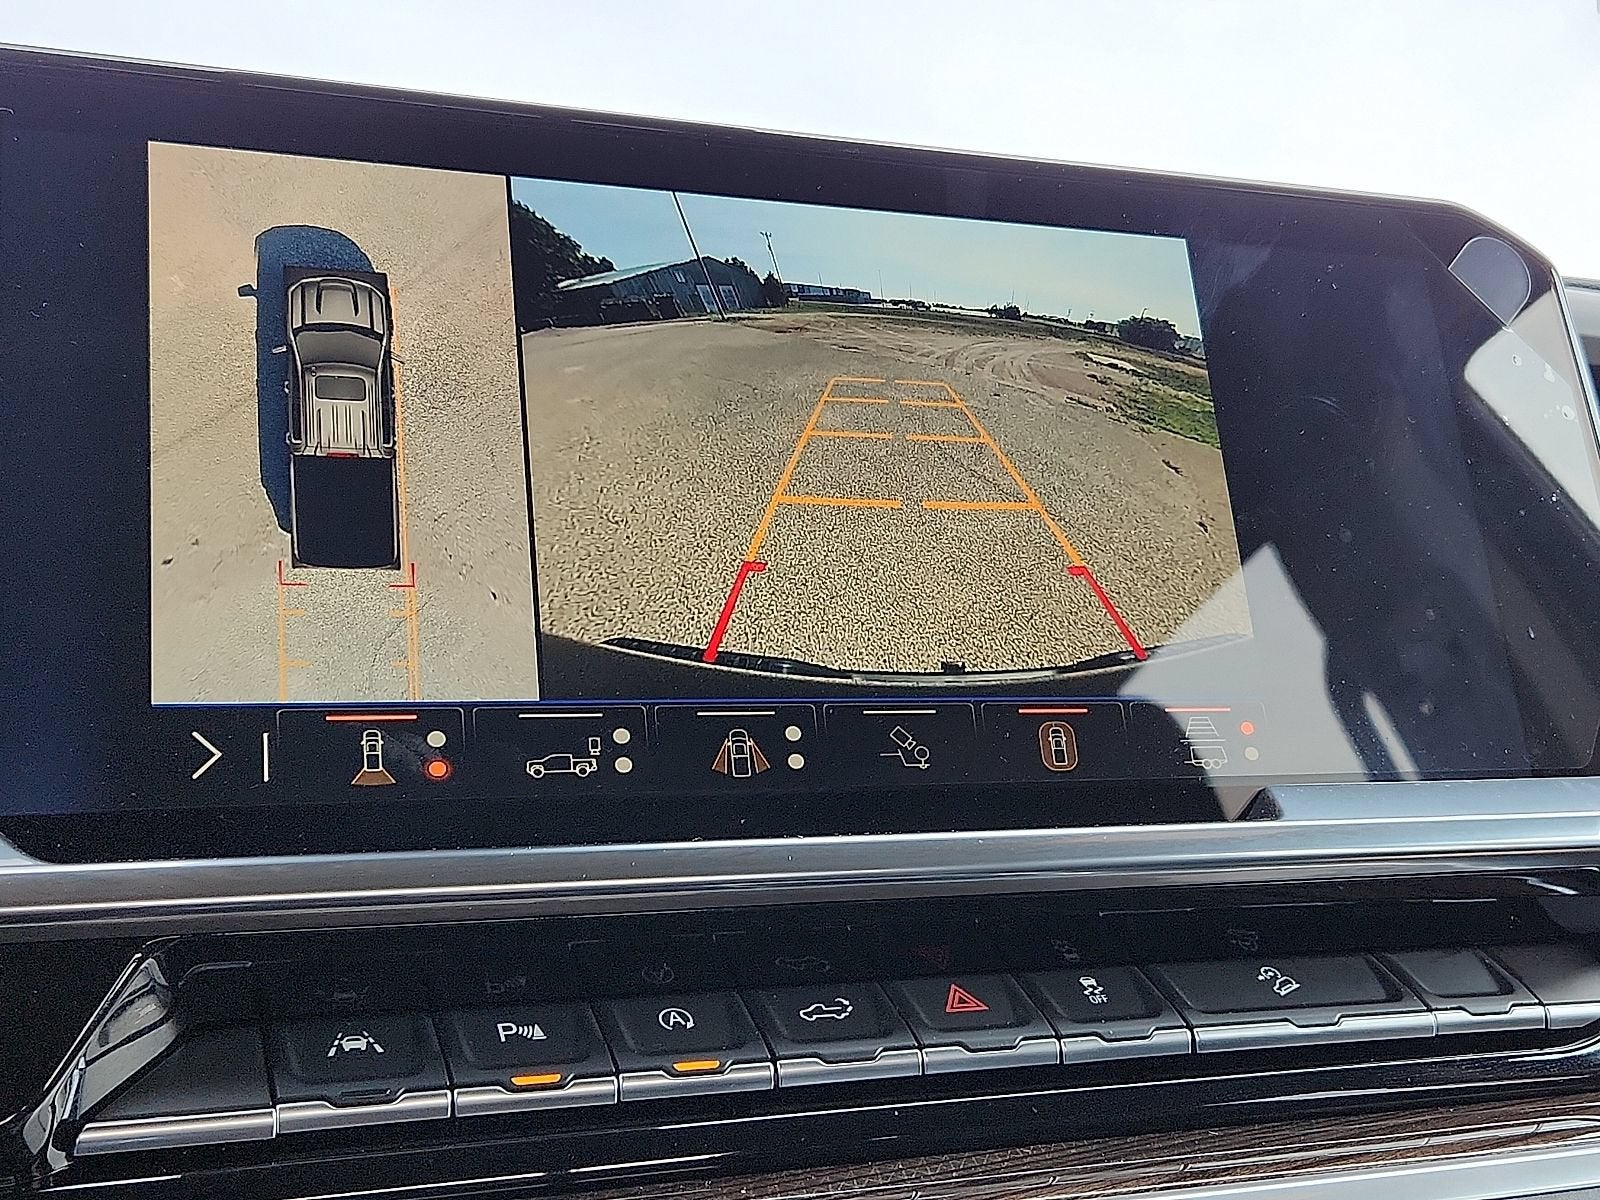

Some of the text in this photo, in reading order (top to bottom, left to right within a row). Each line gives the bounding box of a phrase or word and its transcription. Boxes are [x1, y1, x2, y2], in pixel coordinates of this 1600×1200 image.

[1088, 994, 1109, 1004] OFF
[669, 1011, 686, 1026] A
[497, 1022, 518, 1042] P
